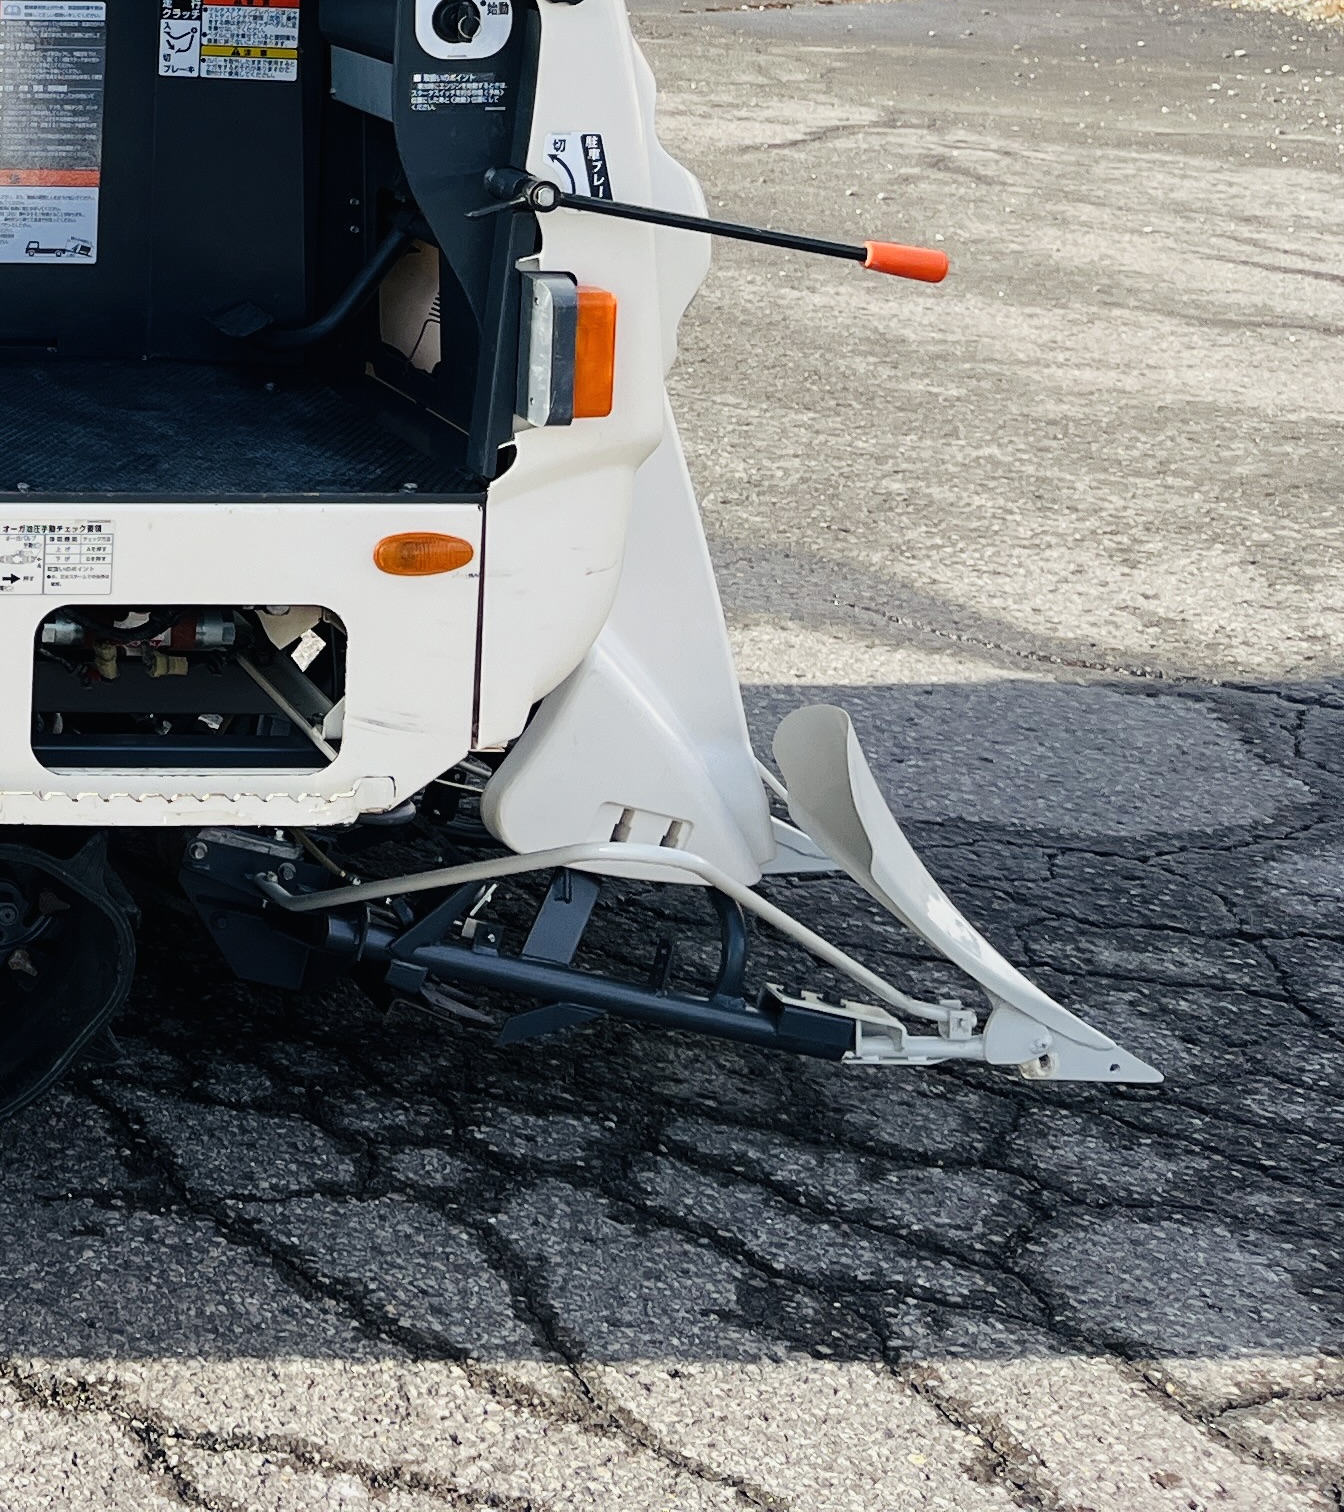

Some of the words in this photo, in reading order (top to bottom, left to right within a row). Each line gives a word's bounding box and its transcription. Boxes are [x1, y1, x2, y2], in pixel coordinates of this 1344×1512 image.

[162, 8, 201, 19] クラッチ
[487, 1, 510, 16] 始動
[553, 139, 567, 153] 切
